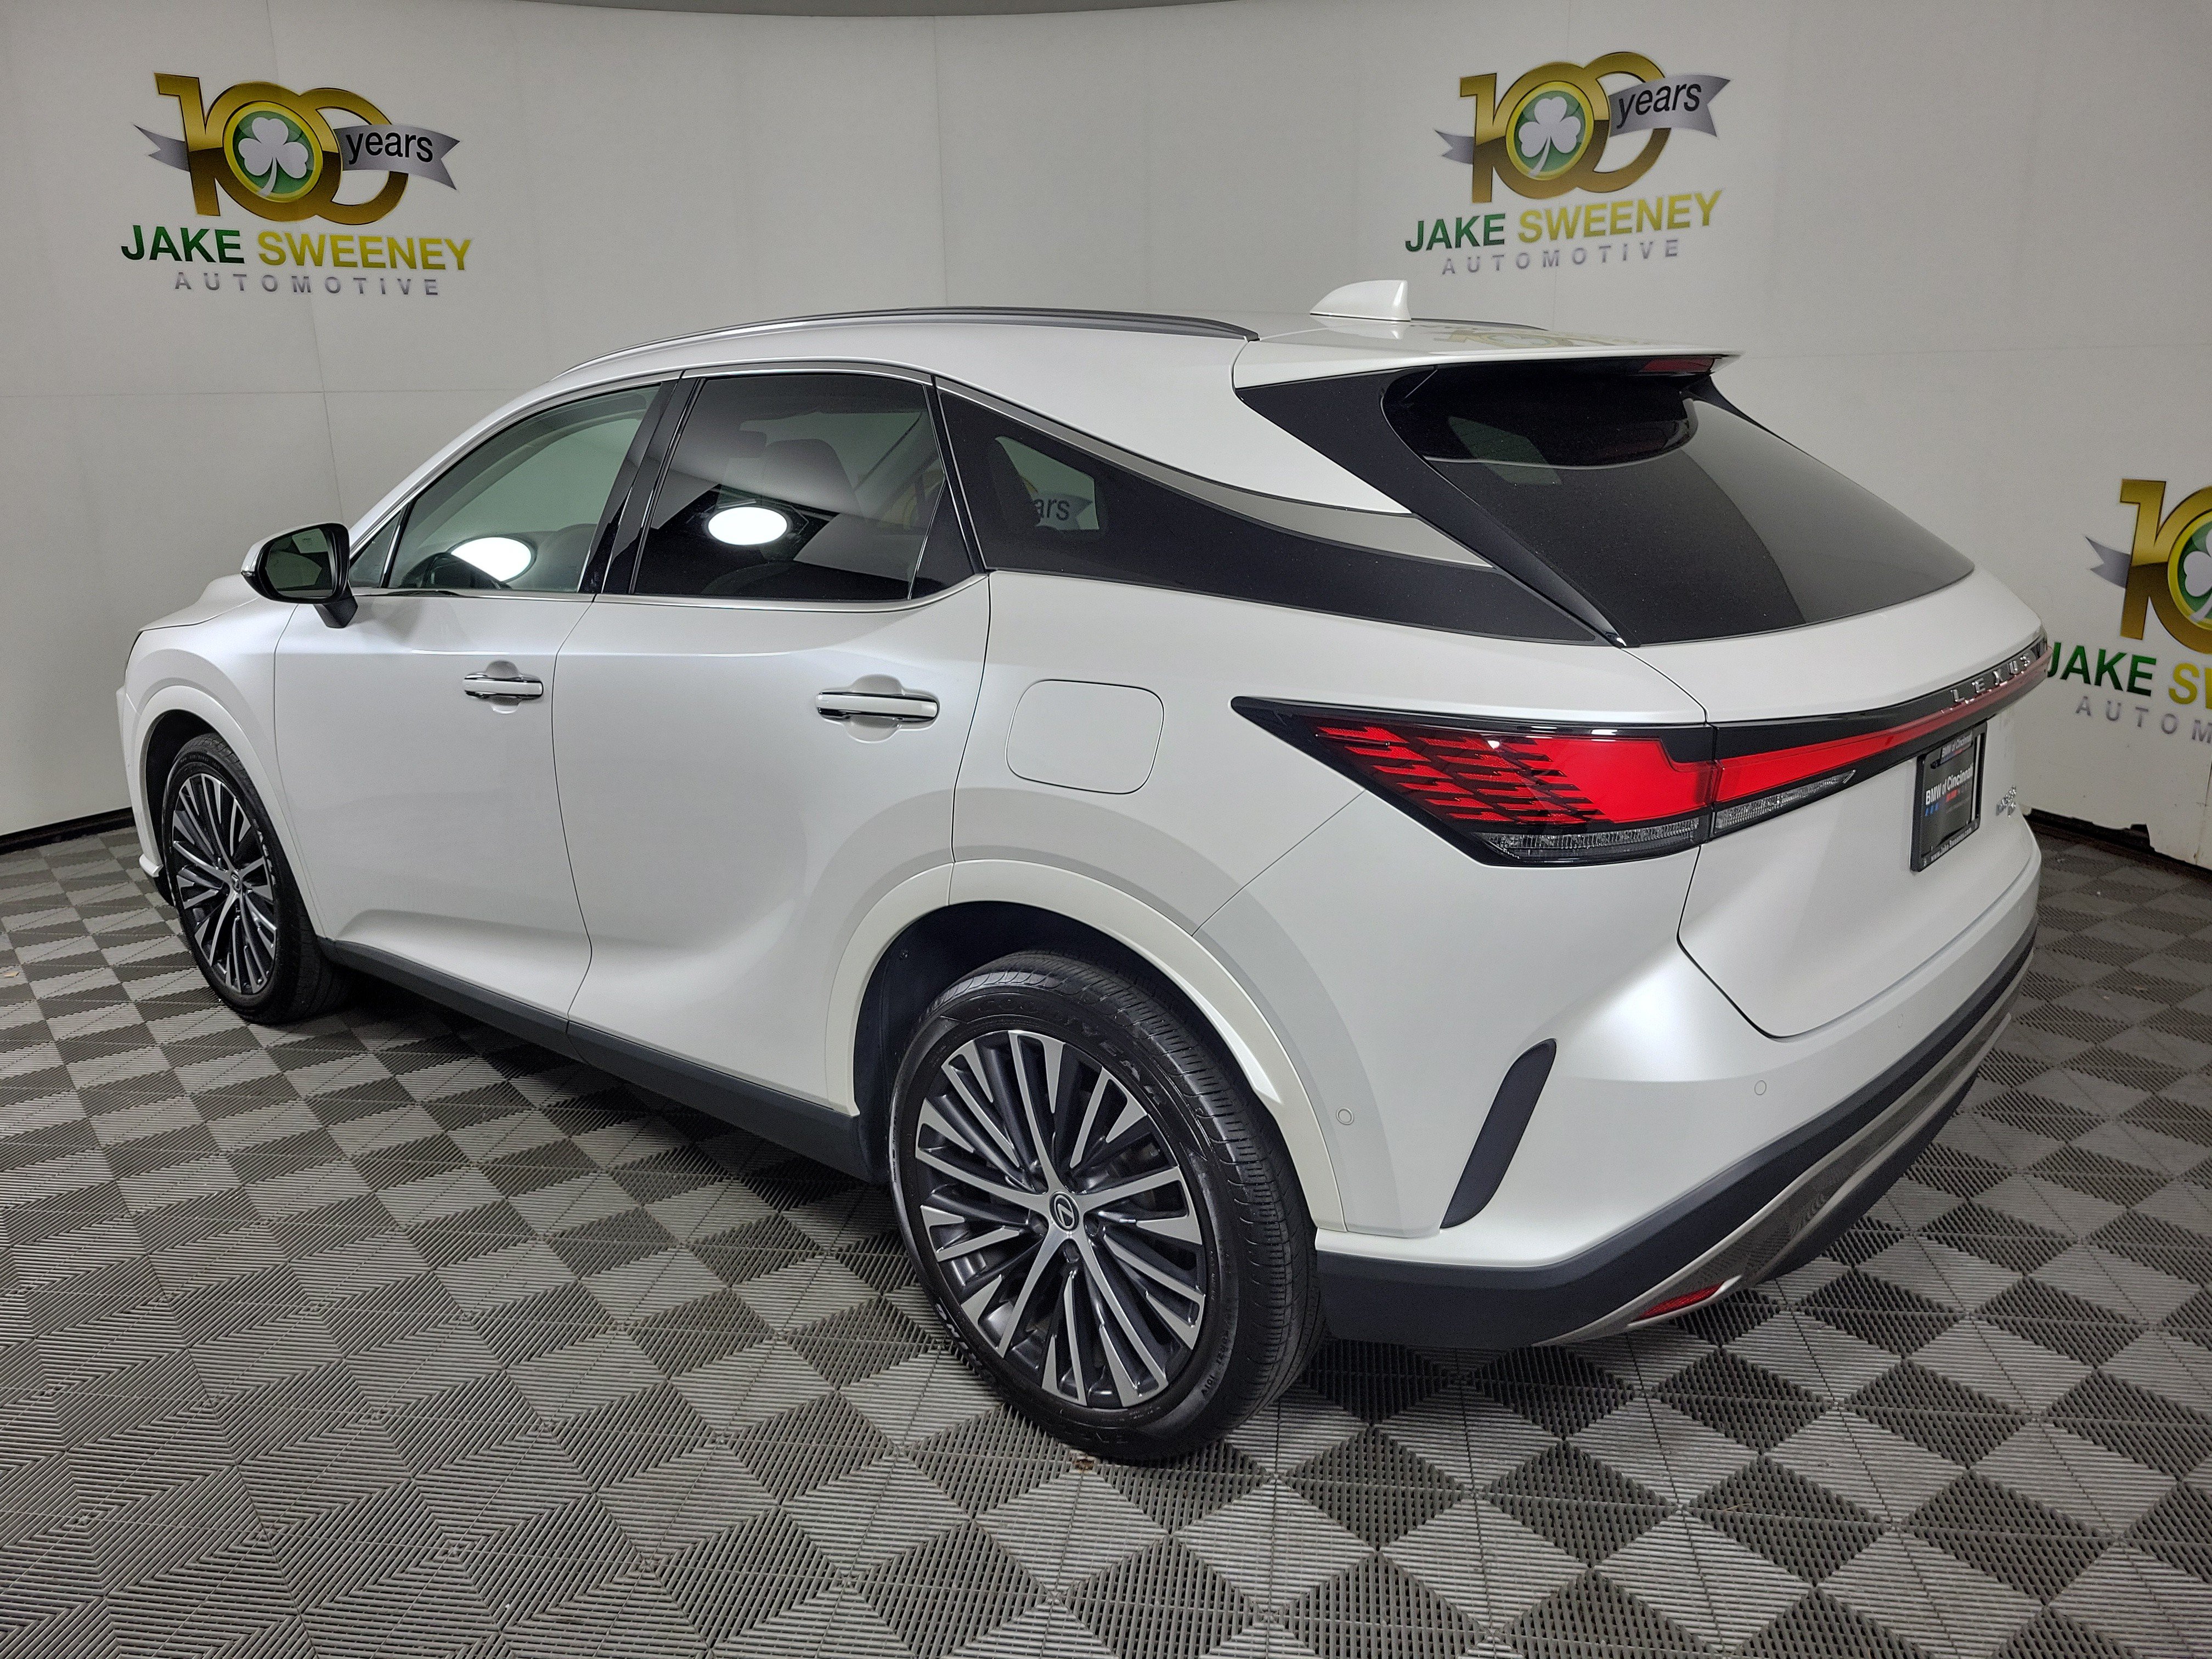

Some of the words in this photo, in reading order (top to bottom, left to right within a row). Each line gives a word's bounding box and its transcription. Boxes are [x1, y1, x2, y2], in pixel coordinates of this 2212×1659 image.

[1617, 83, 1702, 128] years
[346, 132, 433, 165] years
[1405, 213, 1505, 252] JAKE
[1519, 190, 1723, 243] SWEENEY
[121, 224, 245, 264] JAKE
[257, 230, 471, 270] SWEENEY
[1442, 239, 1679, 275] AUTOMOTIVE
[174, 272, 439, 296] AUTOMOTIVE
[1034, 497, 1070, 521] ars
[1950, 652, 2030, 702] LEXUS
[2047, 641, 2157, 697] JAKE
[2169, 662, 2212, 709] S
[1925, 782, 1942, 805] BMW
